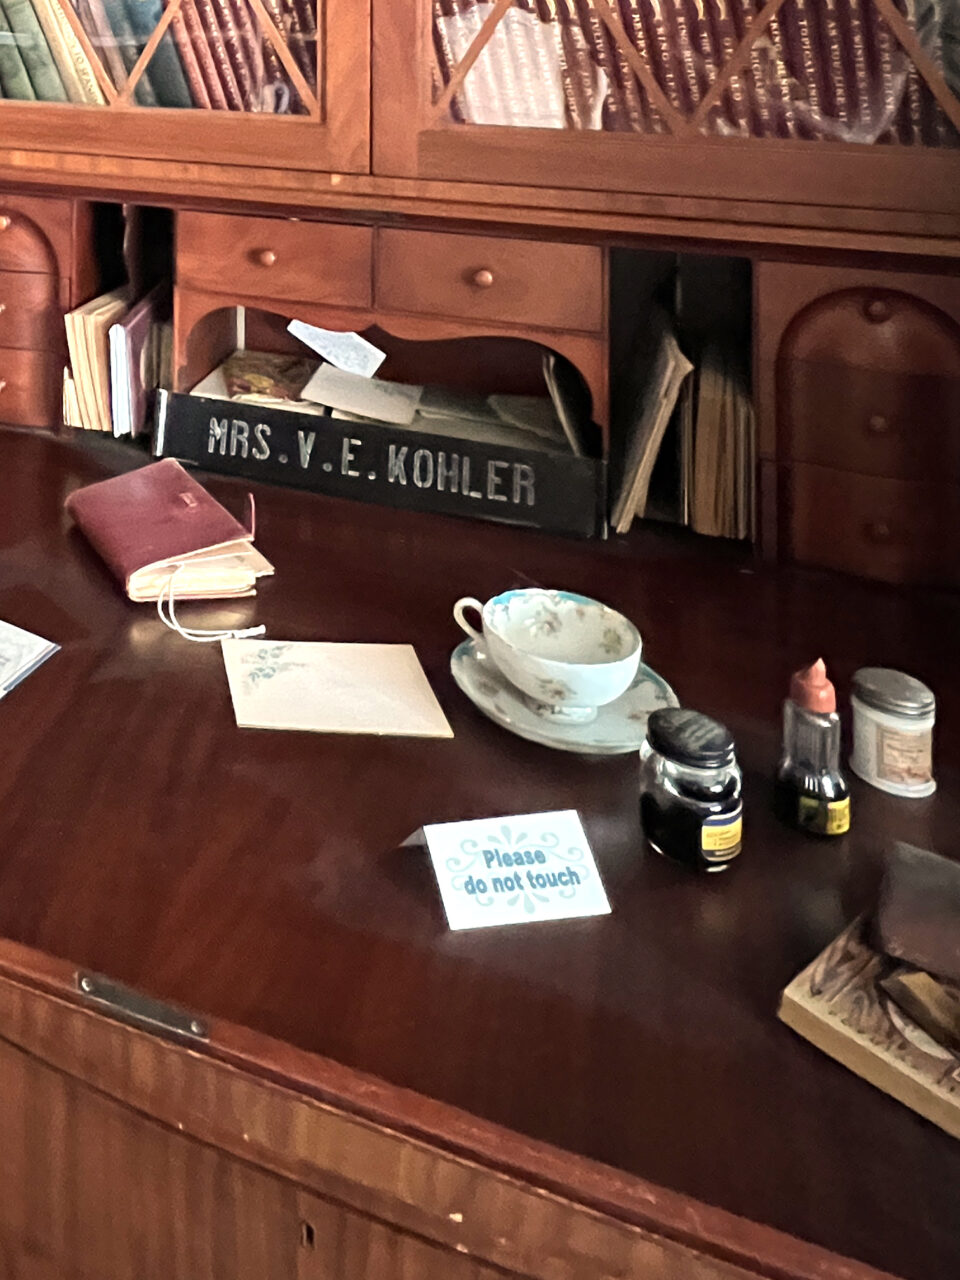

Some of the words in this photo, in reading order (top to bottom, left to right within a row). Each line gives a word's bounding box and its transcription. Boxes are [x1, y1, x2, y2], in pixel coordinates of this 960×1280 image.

[631, 13, 647, 58] HENRY
[656, 26, 670, 61] KING
[797, 19, 815, 73] TOPICAL
[683, 49, 700, 102] RICHARD
[388, 444, 536, 506] KOHLER
[464, 875, 488, 895] do
[492, 871, 524, 893] not
[526, 866, 581, 890] touch
[482, 848, 546, 869] Please
